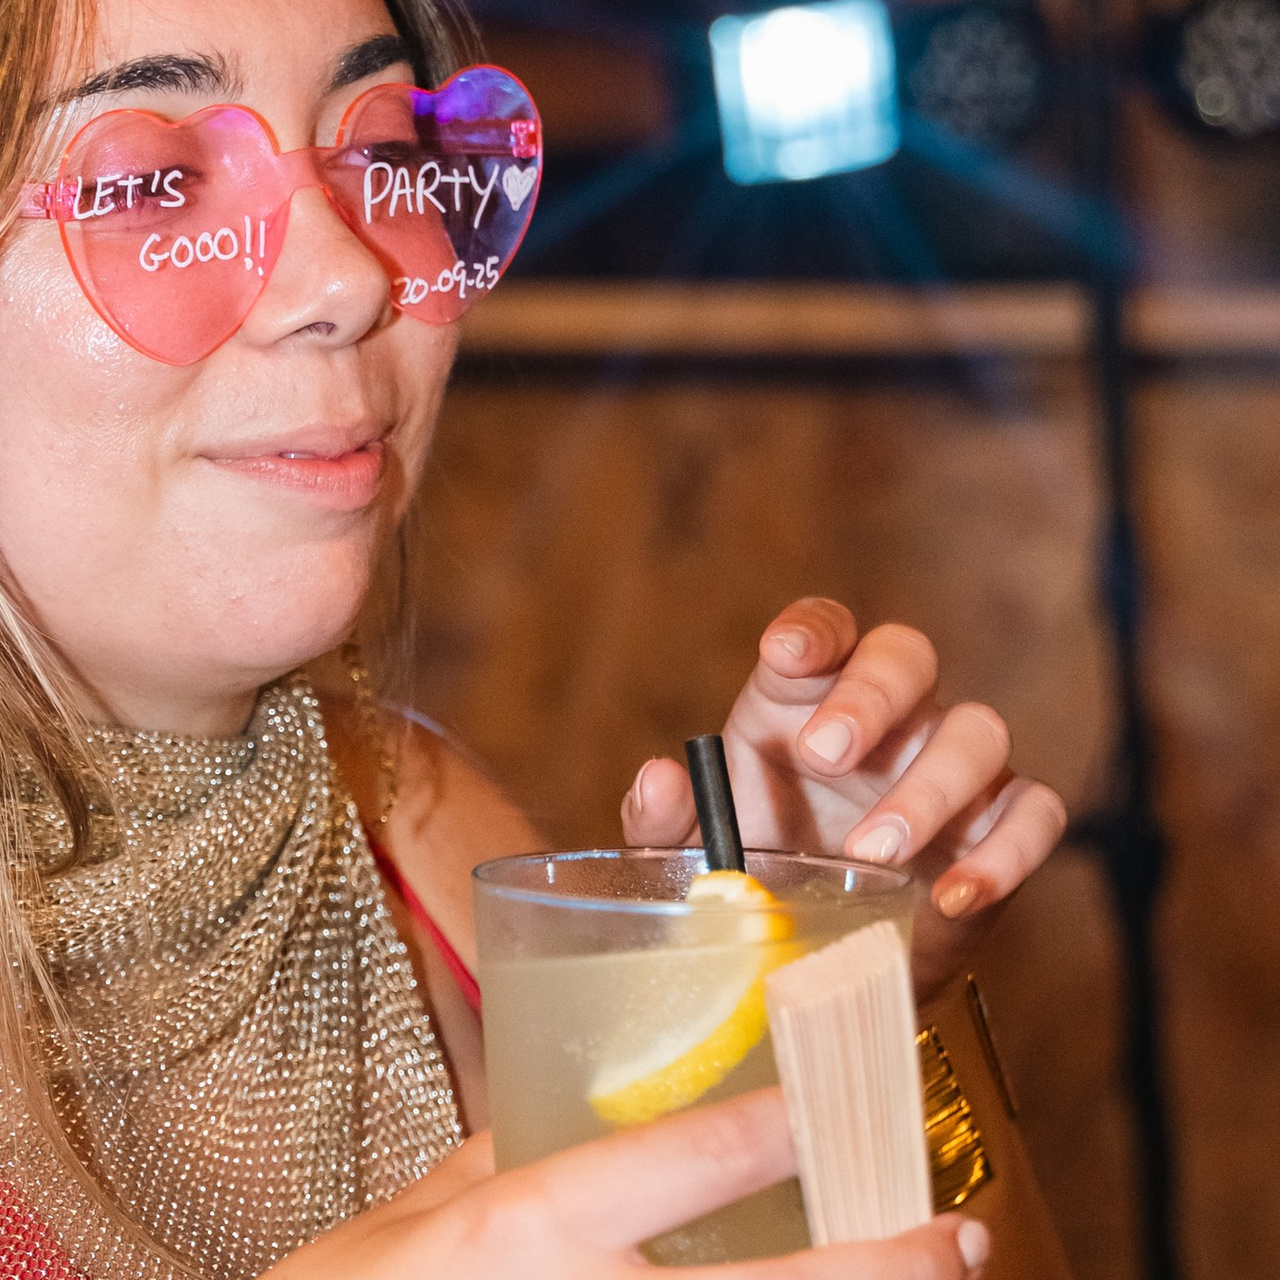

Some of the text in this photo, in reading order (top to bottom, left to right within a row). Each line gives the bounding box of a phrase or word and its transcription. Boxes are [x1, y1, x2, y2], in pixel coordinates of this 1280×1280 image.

[73, 169, 186, 219] LET'S
[363, 161, 500, 229] PARTY
[139, 215, 266, 276] GOOO!!
[395, 256, 500, 305] 20-09-25
